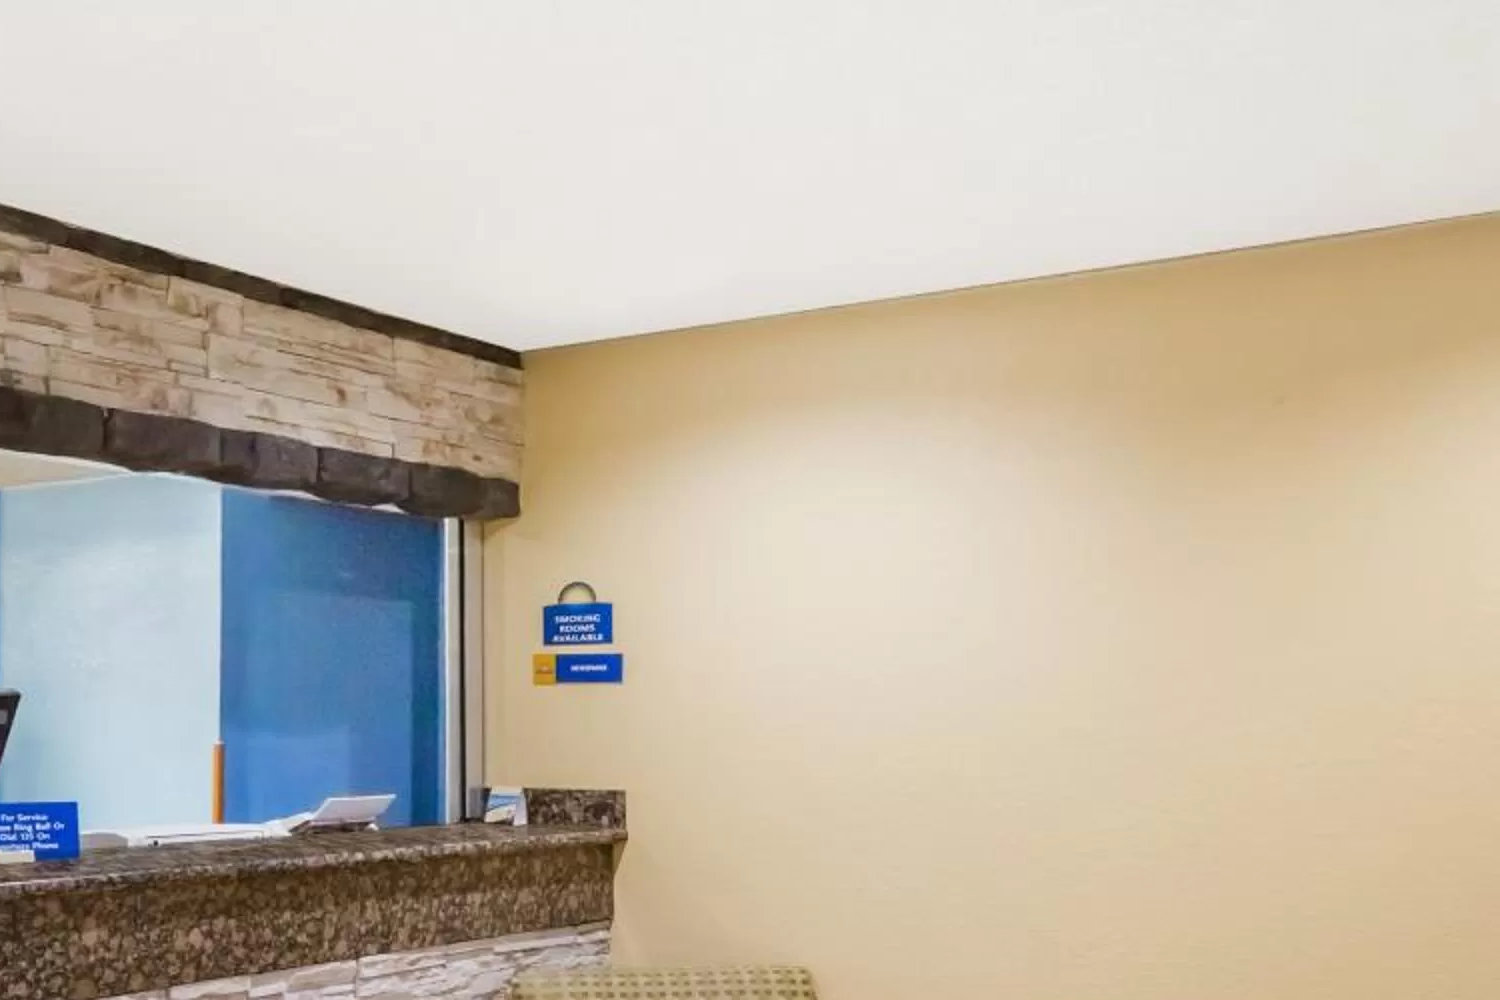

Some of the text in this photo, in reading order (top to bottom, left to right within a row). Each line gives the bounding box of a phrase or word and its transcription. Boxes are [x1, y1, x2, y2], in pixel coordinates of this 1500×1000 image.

[555, 613, 601, 624] SMOKING
[560, 624, 595, 633] ROOMS
[1, 813, 48, 822] For Service
[13, 823, 33, 833] Ring
